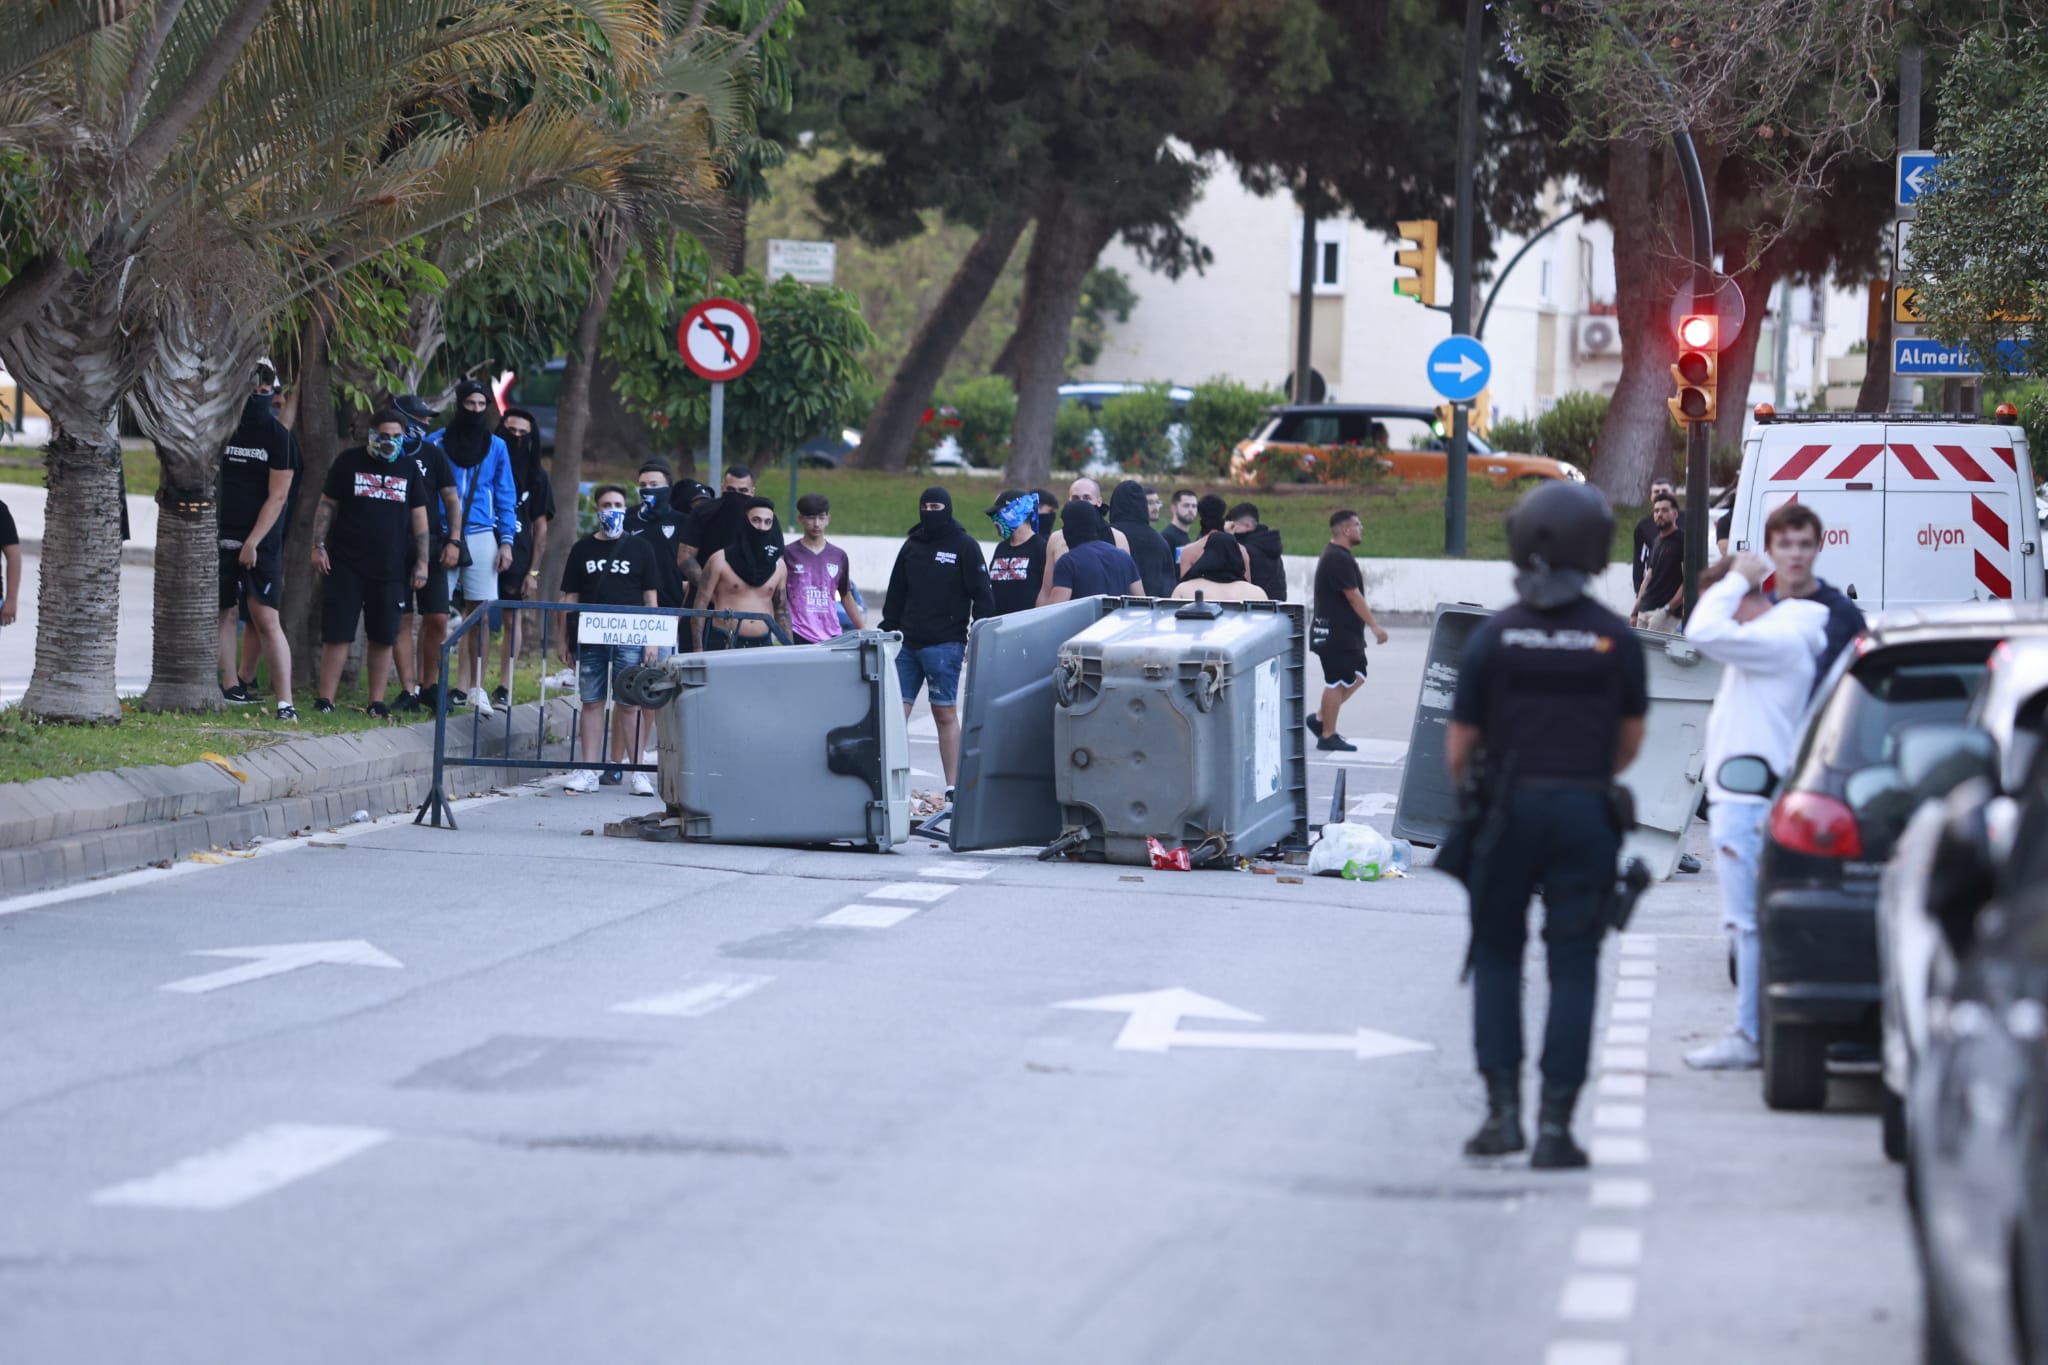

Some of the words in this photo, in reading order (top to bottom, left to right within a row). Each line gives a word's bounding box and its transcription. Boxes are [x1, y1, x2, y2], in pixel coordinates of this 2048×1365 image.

[1819, 529, 1849, 552] yon
[1917, 523, 1964, 552] alyon
[586, 617, 627, 629] POLICIA
[633, 619, 668, 631] LOCAL
